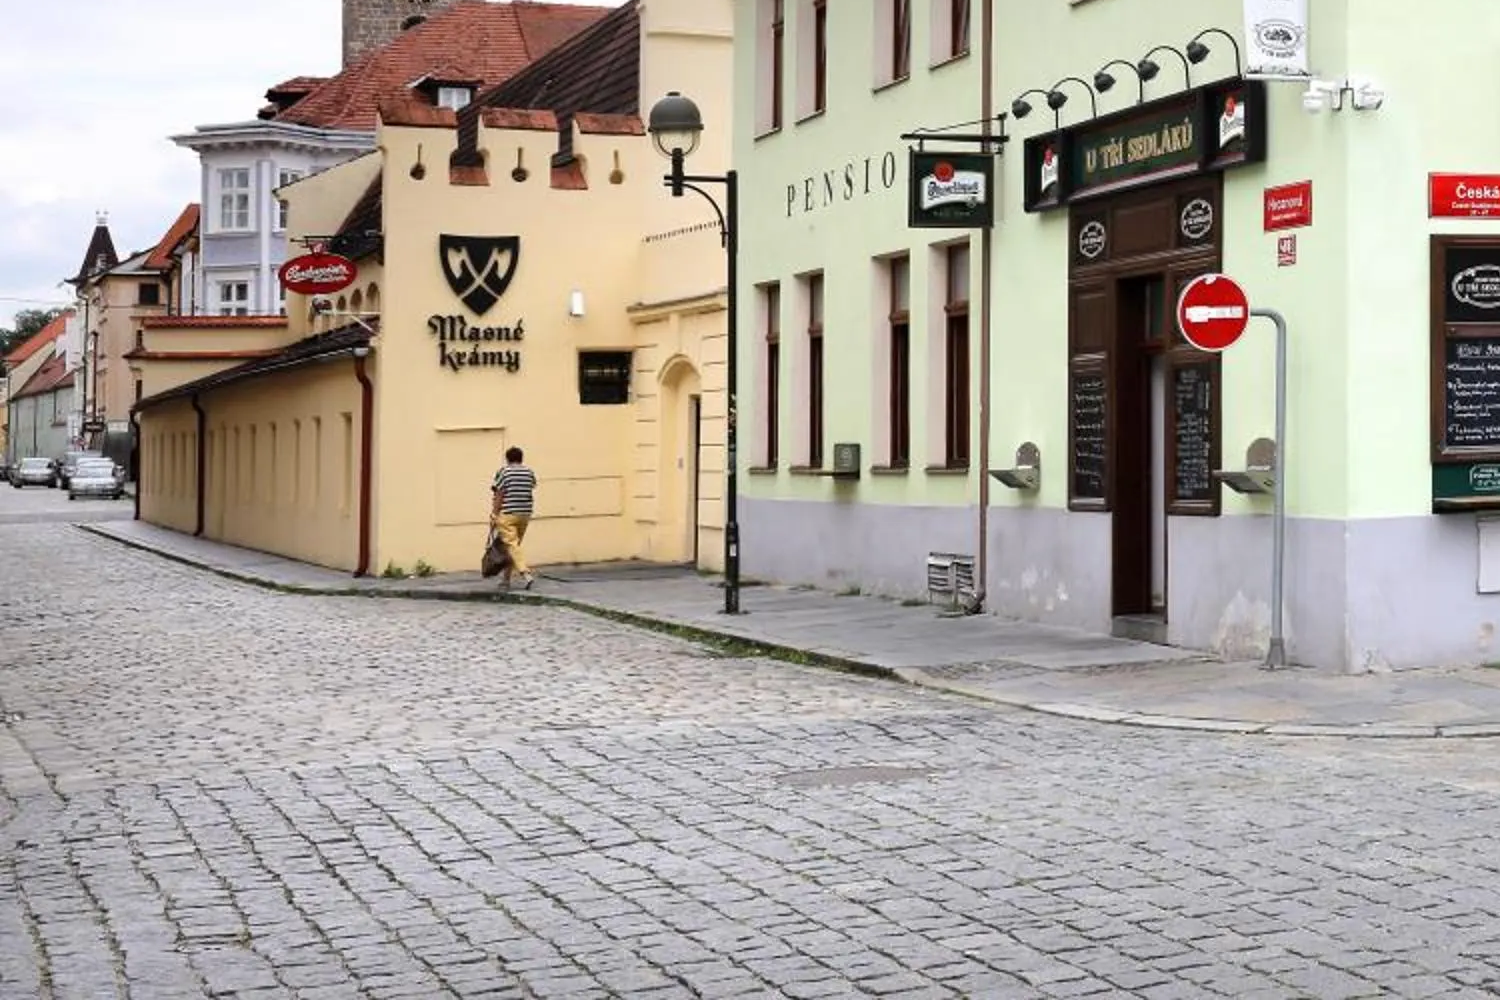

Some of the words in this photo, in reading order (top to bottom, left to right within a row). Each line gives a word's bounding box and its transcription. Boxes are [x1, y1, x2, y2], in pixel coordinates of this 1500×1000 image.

[1085, 151, 1096, 173] U
[1101, 136, 1123, 169] TŘÍ
[1127, 116, 1193, 161] SEDLÁKŮ
[787, 146, 913, 217] PENSIO
[1456, 182, 1500, 199] Česká
